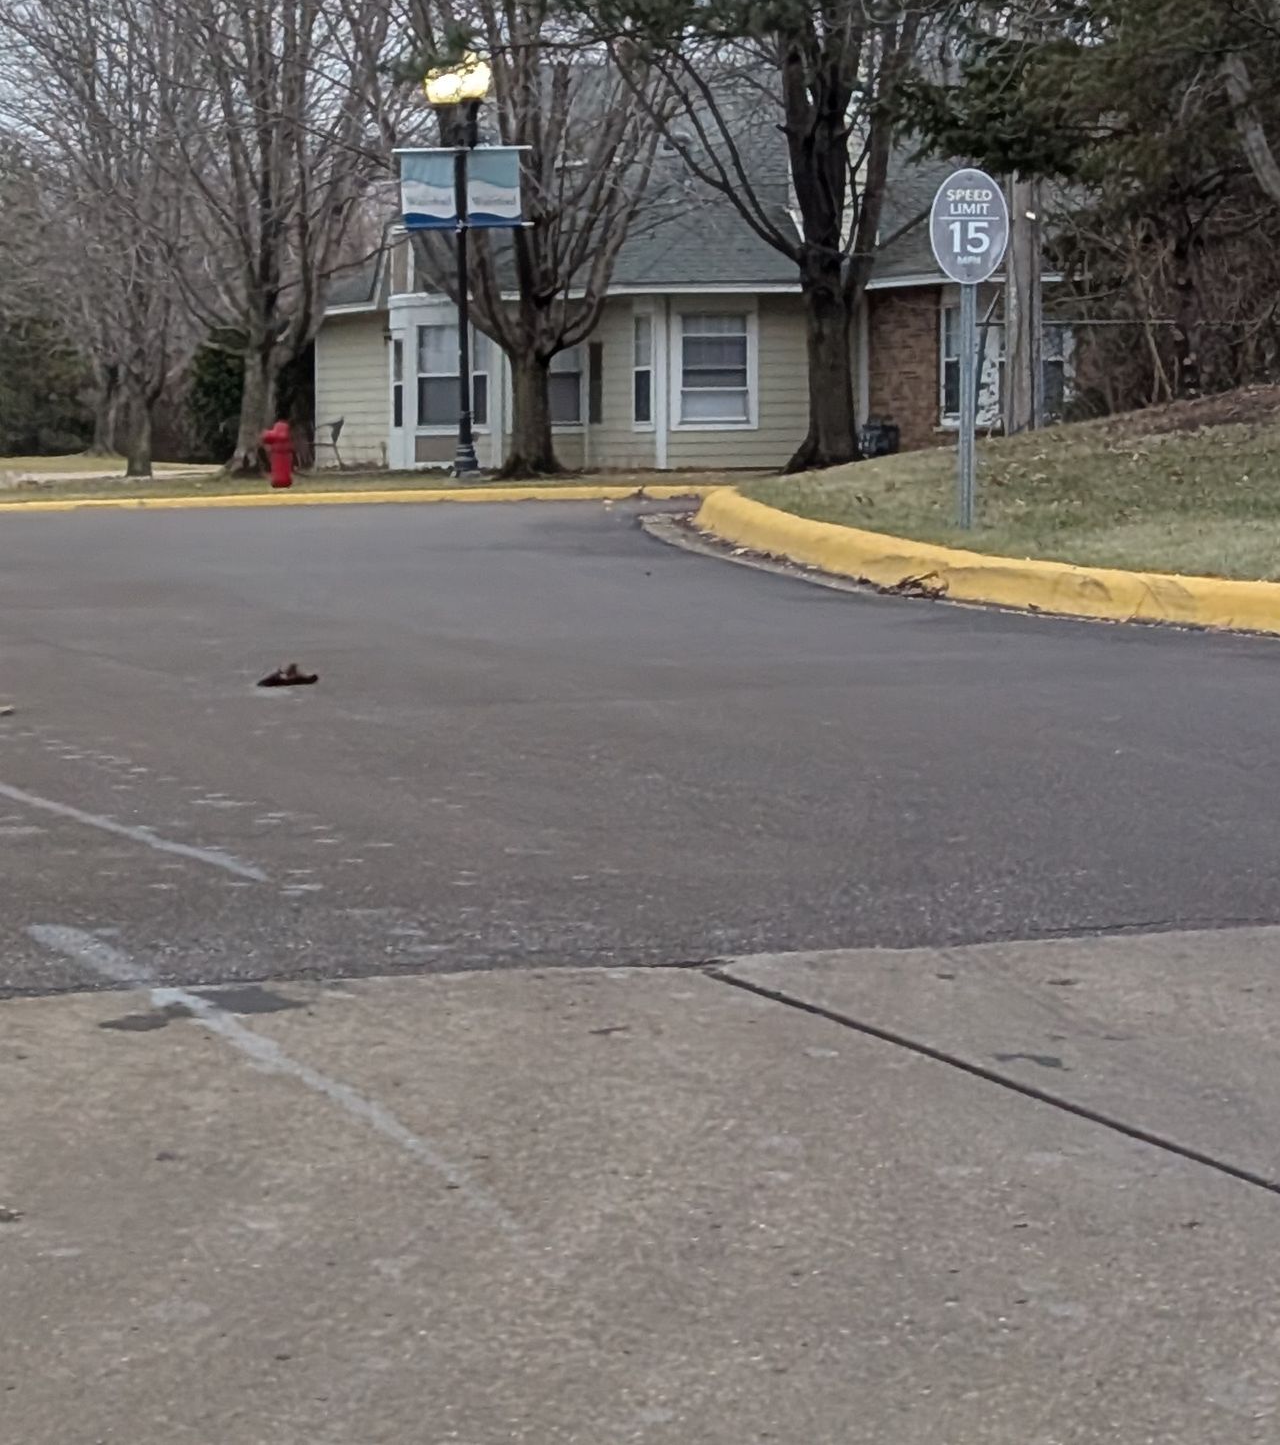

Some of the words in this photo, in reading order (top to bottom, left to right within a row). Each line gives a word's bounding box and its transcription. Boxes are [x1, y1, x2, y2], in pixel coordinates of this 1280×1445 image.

[946, 189, 992, 201] SPEED
[950, 203, 991, 215] LIMIT
[949, 221, 990, 254] 15
